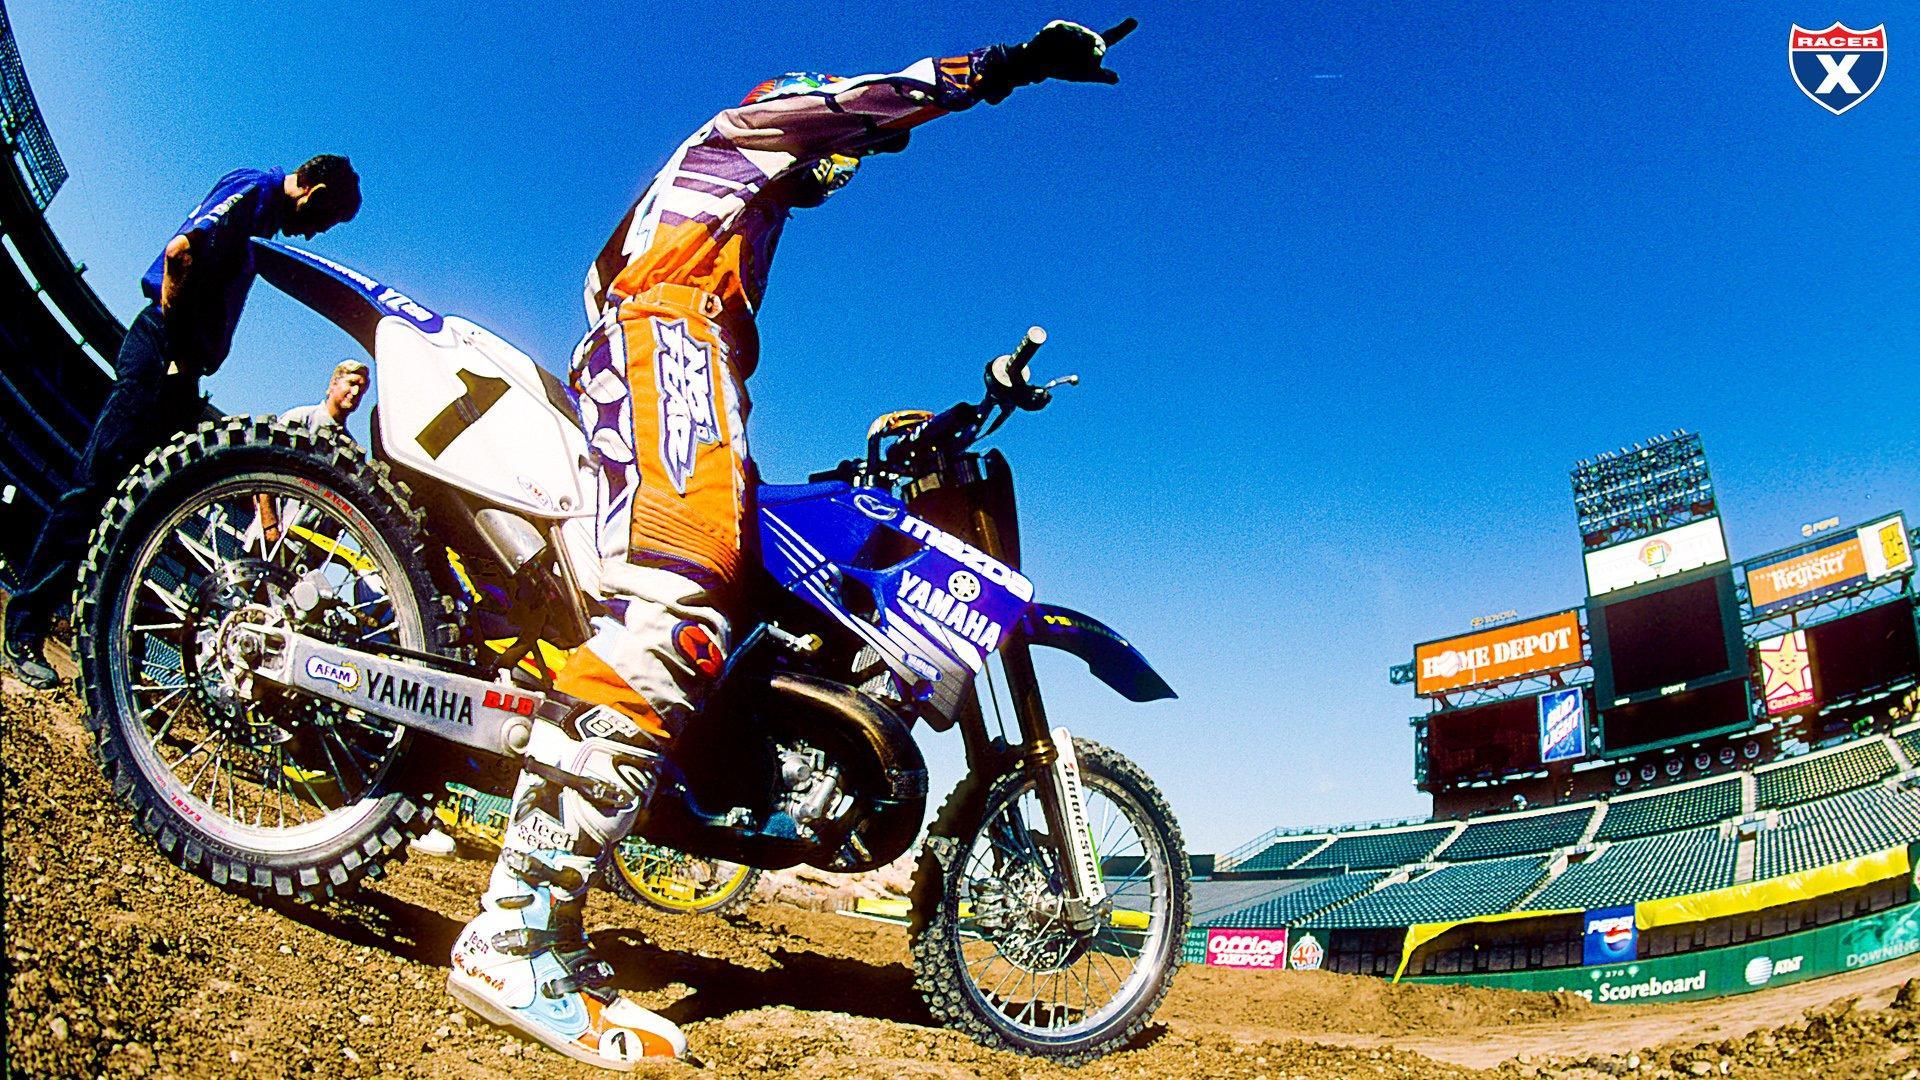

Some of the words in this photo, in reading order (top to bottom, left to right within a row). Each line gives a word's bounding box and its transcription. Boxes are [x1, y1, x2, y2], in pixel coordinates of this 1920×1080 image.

[415, 368, 511, 461] 1
[900, 570, 1002, 653] YAMAHA
[1493, 627, 1572, 664] DEPOT
[314, 663, 351, 682] AFAM
[366, 669, 474, 727] YAMAHA
[1546, 694, 1576, 732] BUD
[1543, 709, 1581, 755] LIGHT
[1587, 915, 1634, 935] PEPSI
[1208, 935, 1284, 956] Office
[1598, 969, 1706, 1002] Scoreboard
